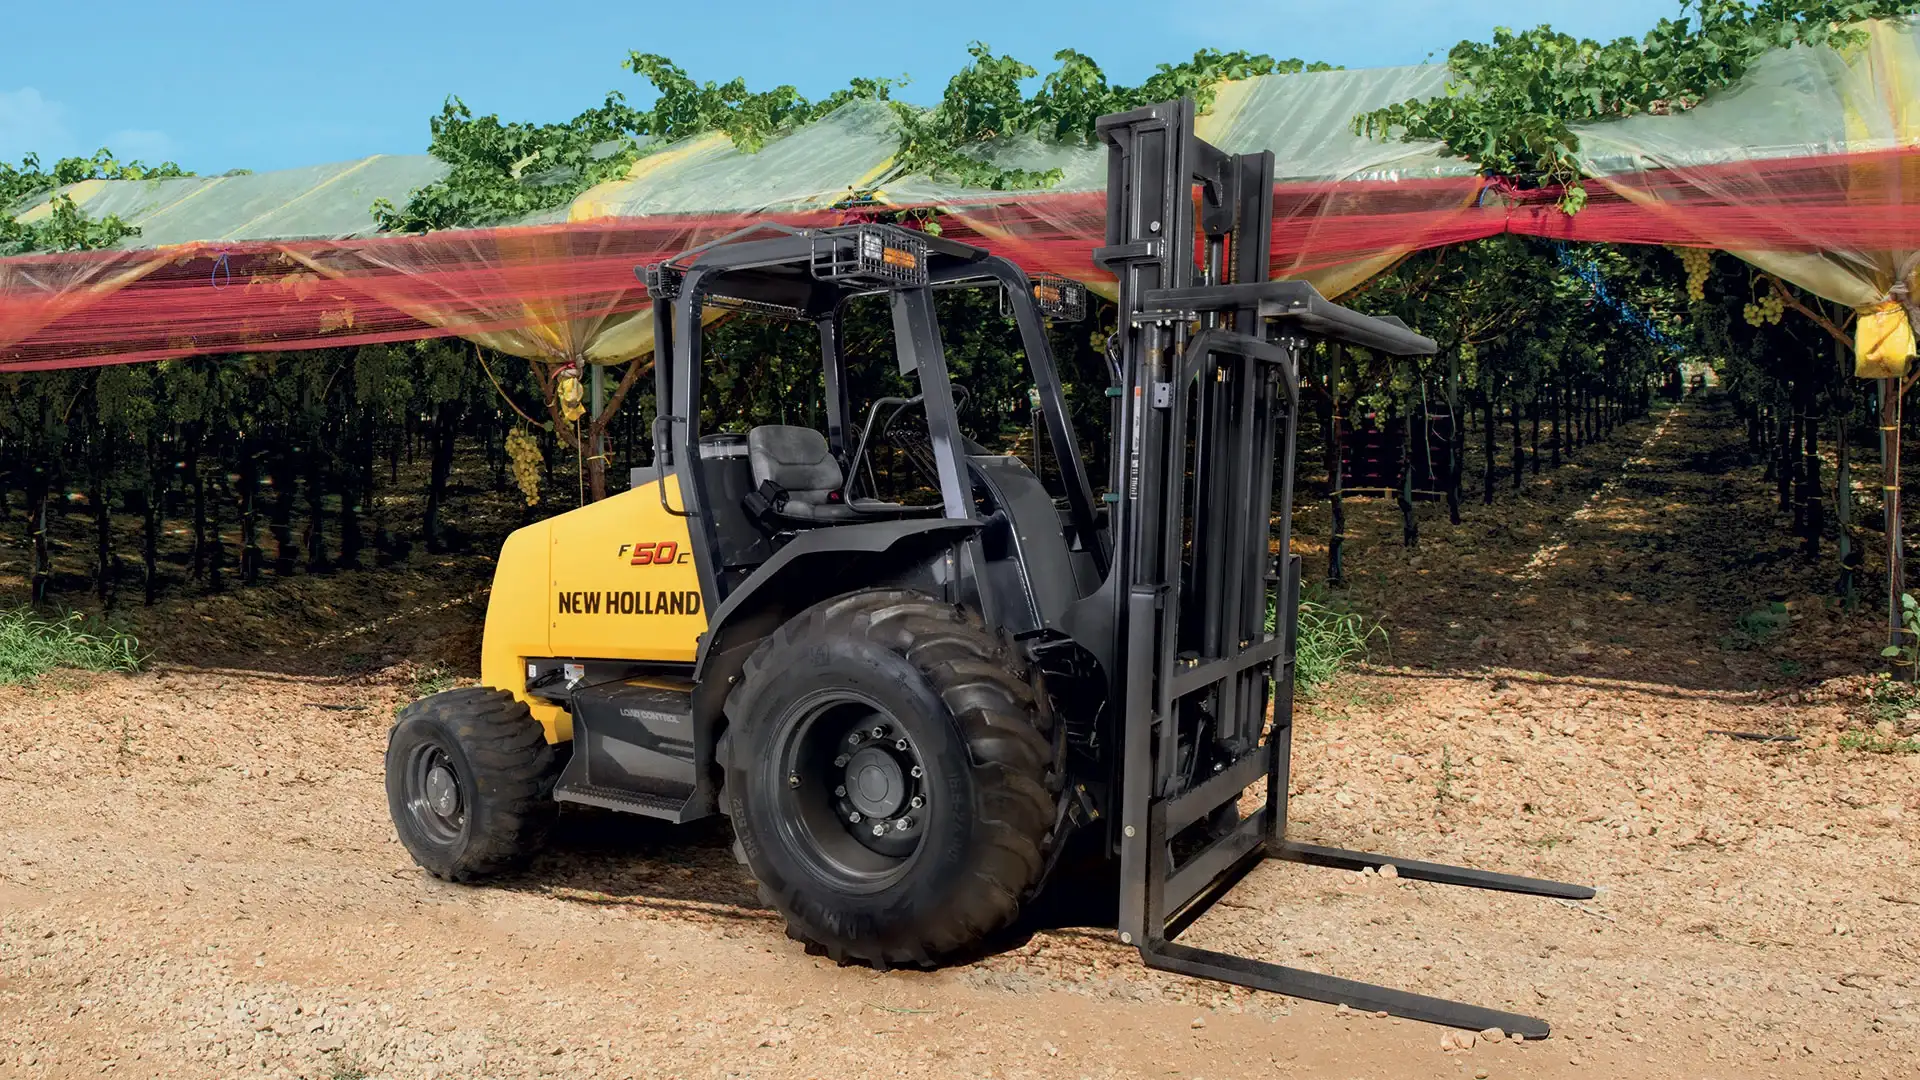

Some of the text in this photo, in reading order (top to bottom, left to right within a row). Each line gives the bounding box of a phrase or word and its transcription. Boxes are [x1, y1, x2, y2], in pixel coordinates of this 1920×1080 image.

[558, 591, 701, 615] NEW HOLLAND
[620, 708, 680, 724] LOAD CONTROL
